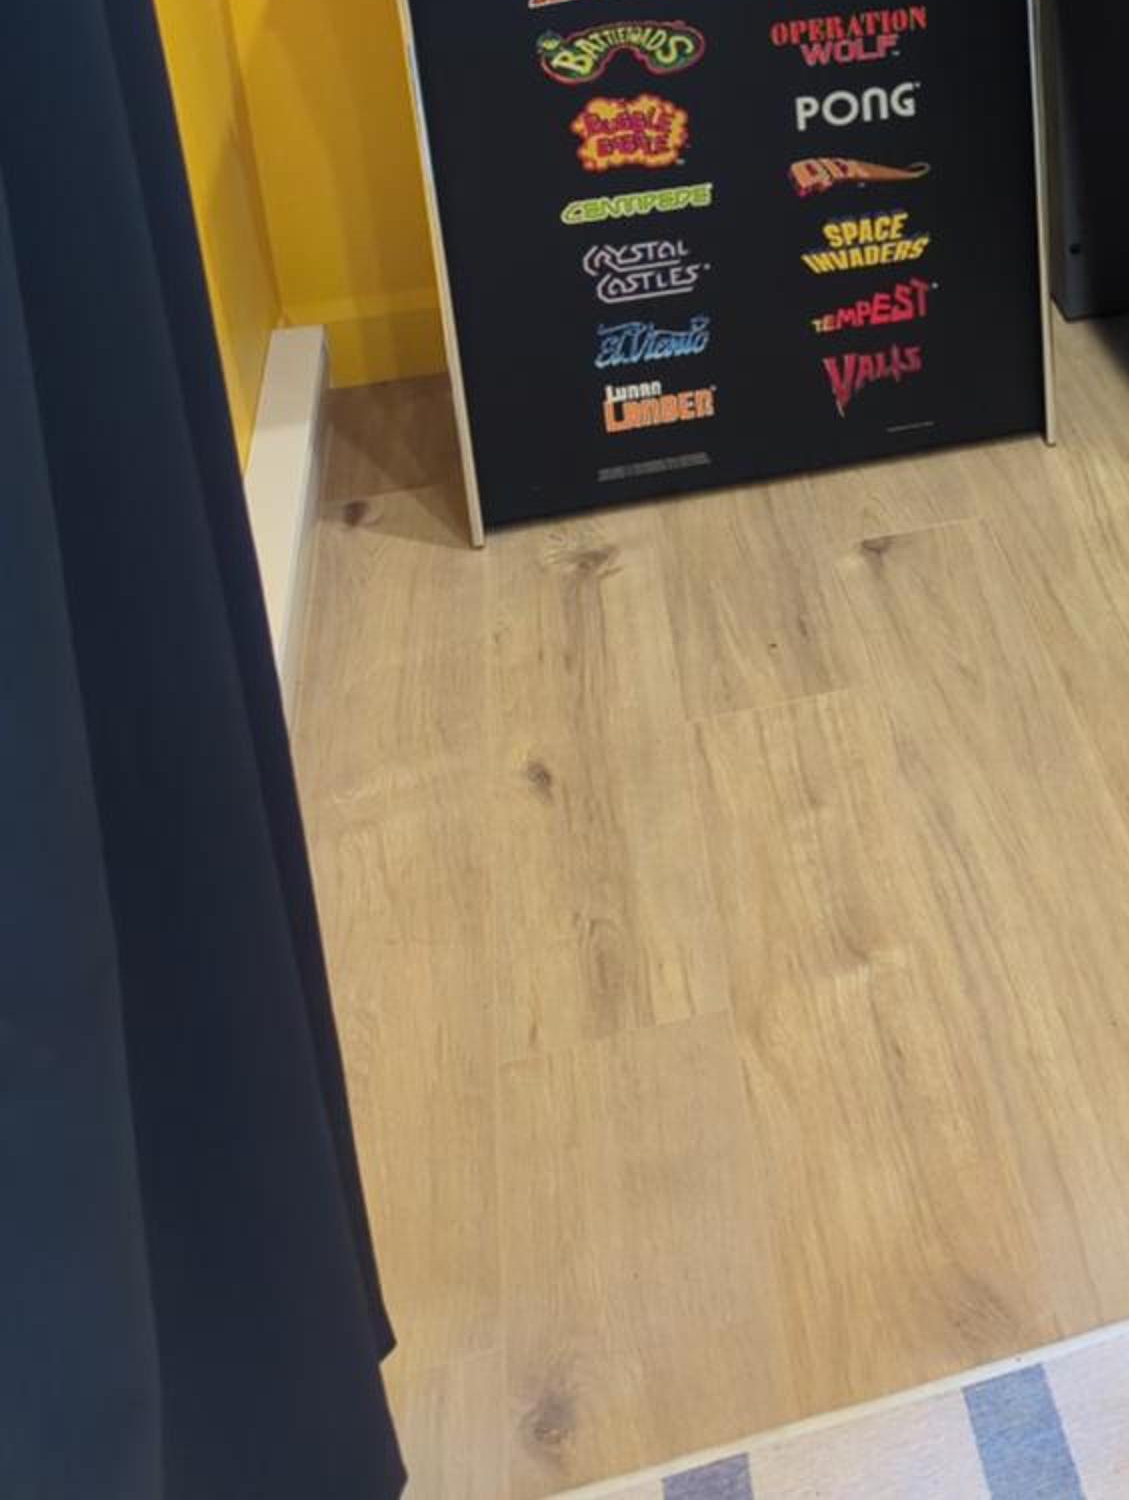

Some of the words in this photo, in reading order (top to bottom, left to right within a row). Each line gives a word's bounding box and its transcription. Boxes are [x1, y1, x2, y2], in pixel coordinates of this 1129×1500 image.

[770, 5, 927, 45] OPERATION
[801, 34, 899, 66] WOLF
[795, 82, 916, 132] PONG
[561, 182, 713, 225] CENTIPEDE
[823, 211, 909, 248] SPACE
[801, 235, 929, 274] INVADERS
[597, 264, 701, 303] CASTLES
[811, 278, 928, 332] TEMPEST
